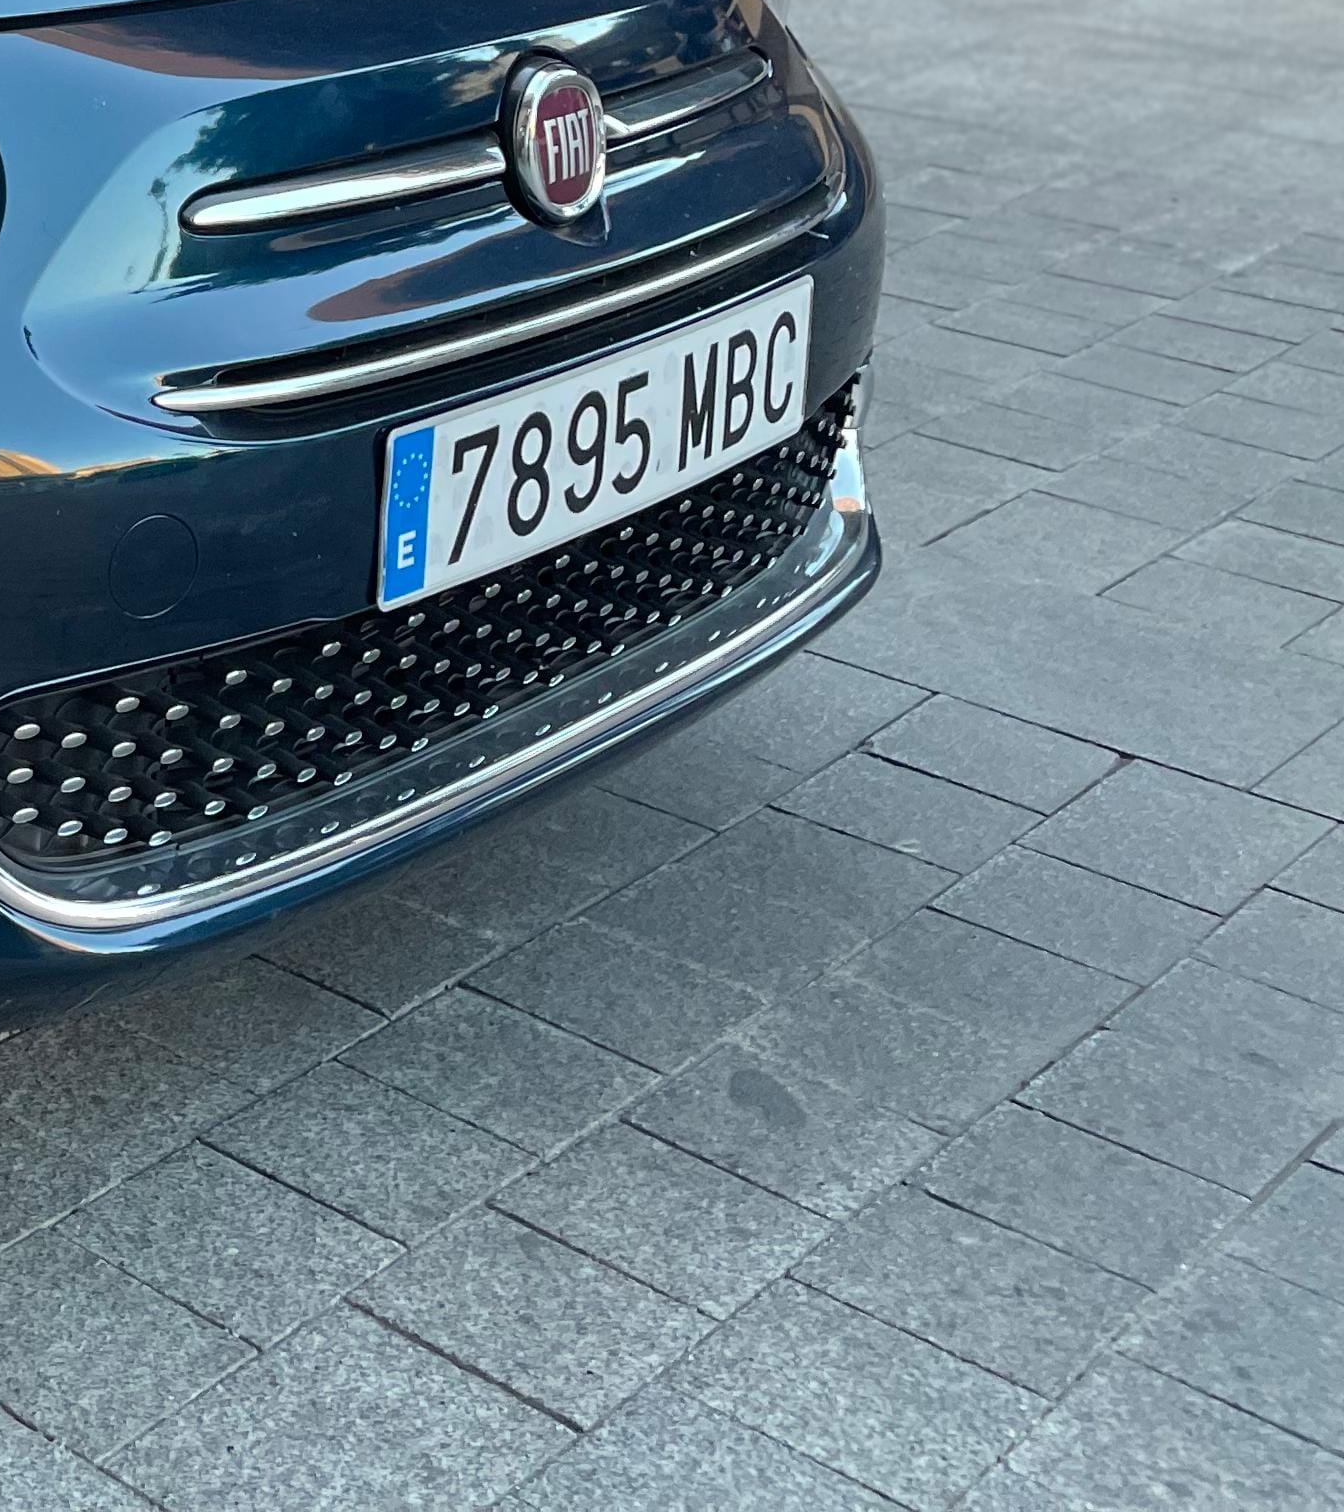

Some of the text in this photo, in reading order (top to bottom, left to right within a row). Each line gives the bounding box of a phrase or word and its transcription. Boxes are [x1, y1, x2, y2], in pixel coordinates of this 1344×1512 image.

[542, 109, 593, 185] FIAT
[448, 311, 797, 565] 7895 MBC
[397, 531, 416, 568] E
